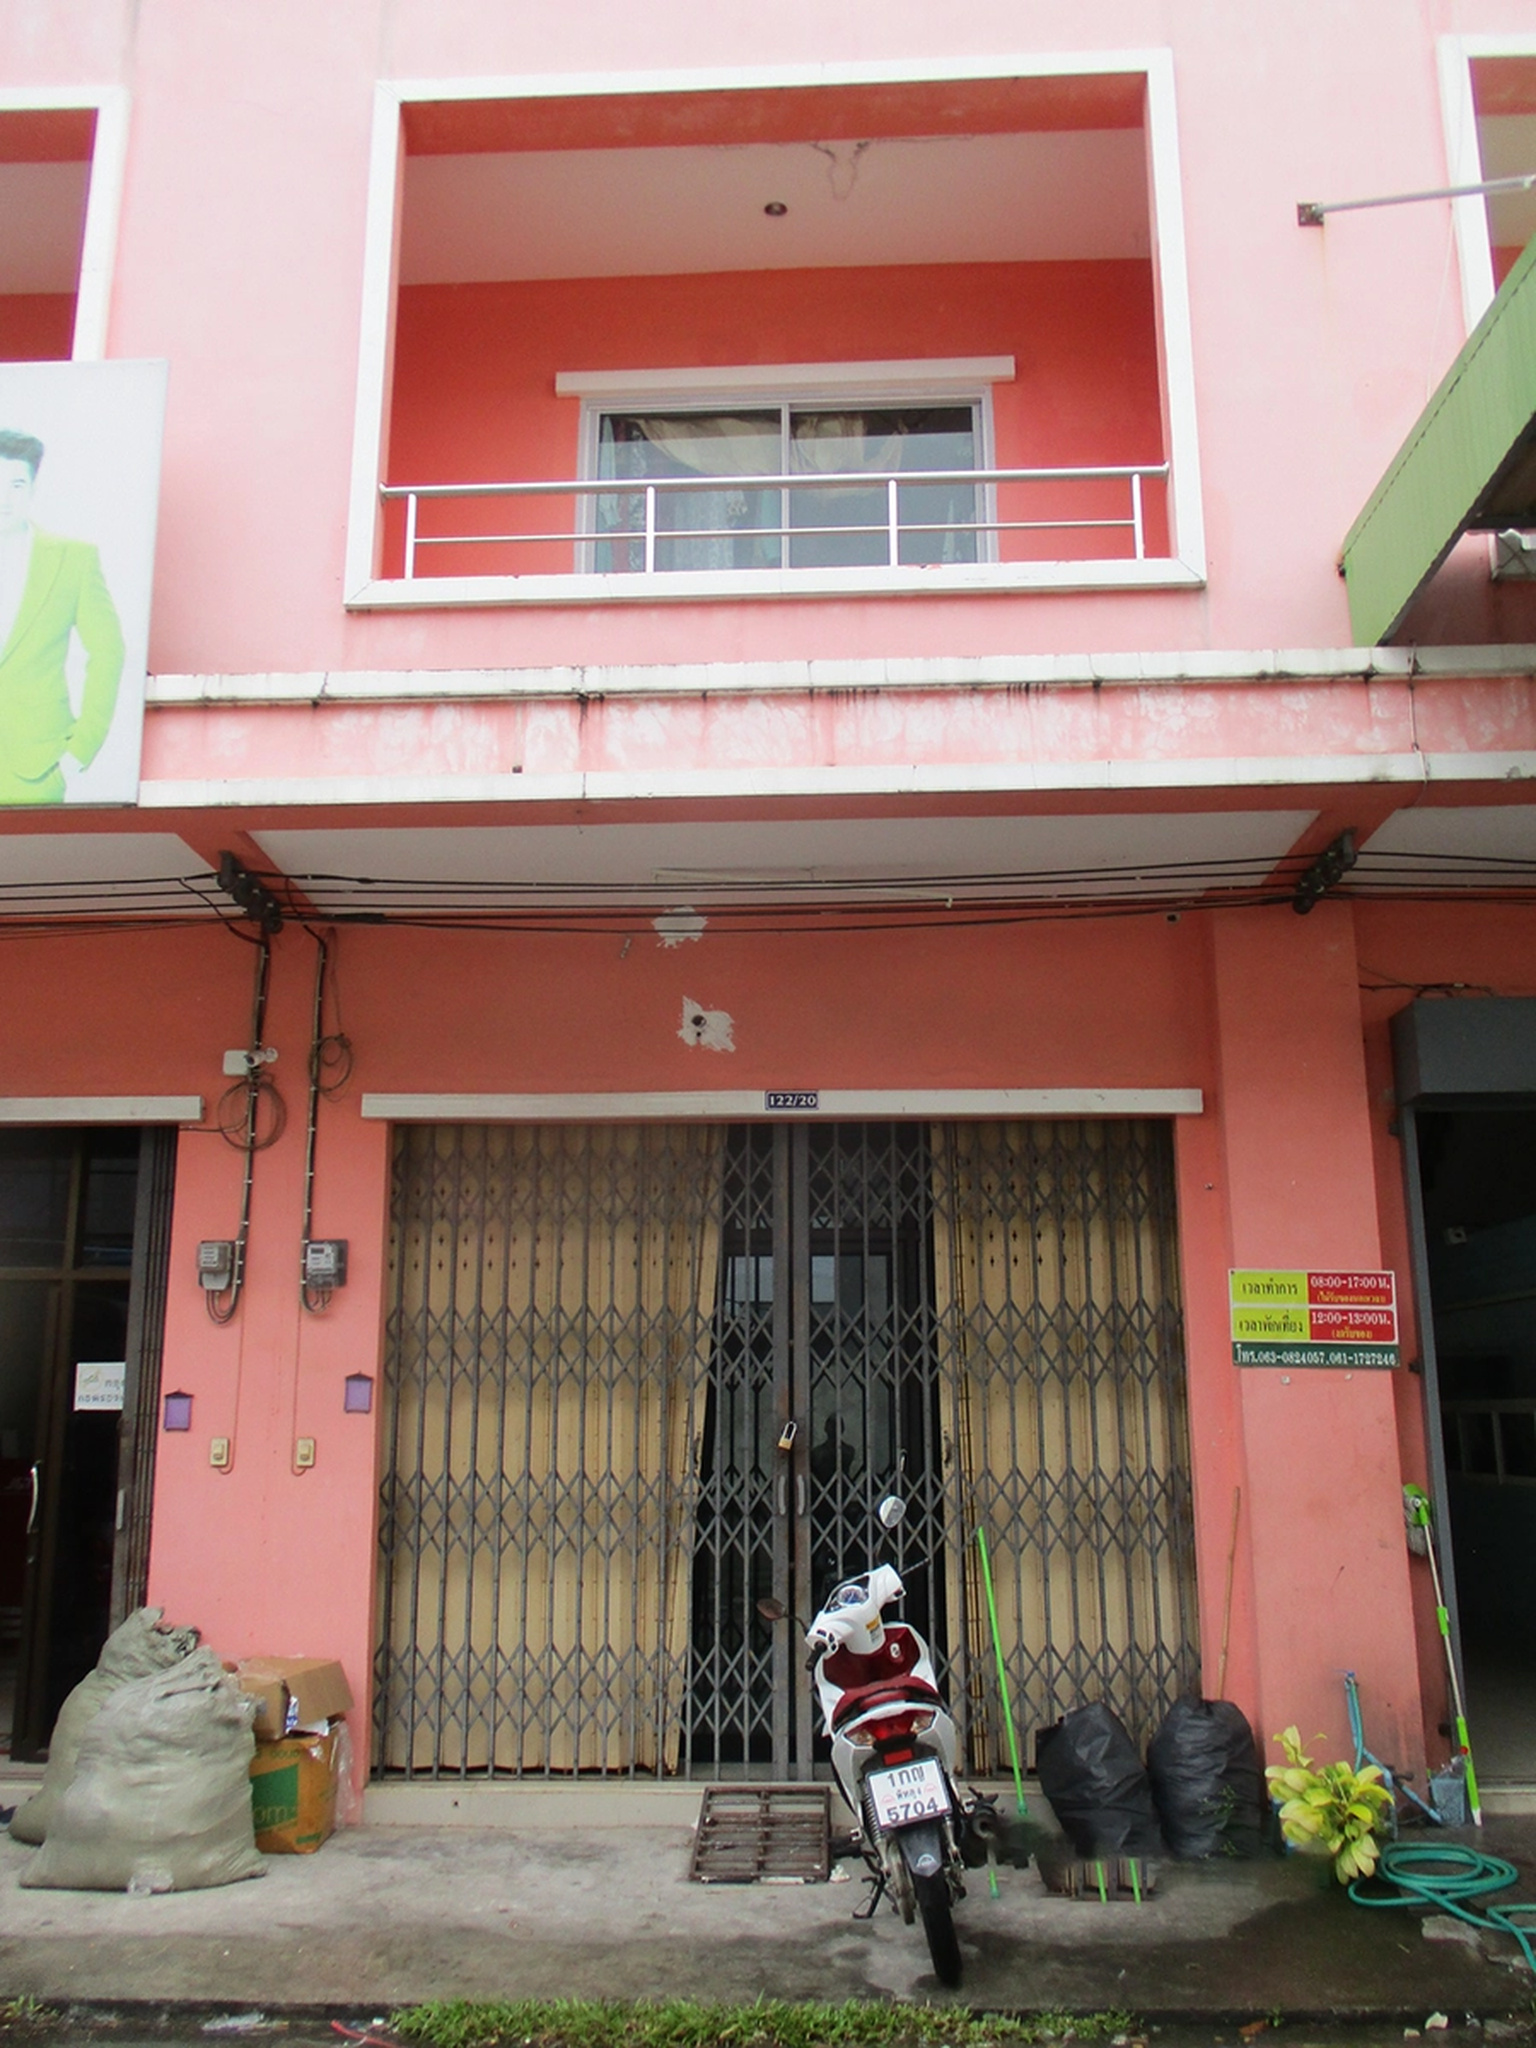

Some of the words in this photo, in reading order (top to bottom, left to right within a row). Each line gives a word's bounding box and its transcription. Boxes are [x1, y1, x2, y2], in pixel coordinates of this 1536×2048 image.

[769, 1094, 817, 1106] 122/20
[1242, 1277, 1298, 1295] เวลาทำการ
[1239, 1309, 1304, 1333] เวลาพักเที่ยง
[886, 1796, 939, 1824] 5704
